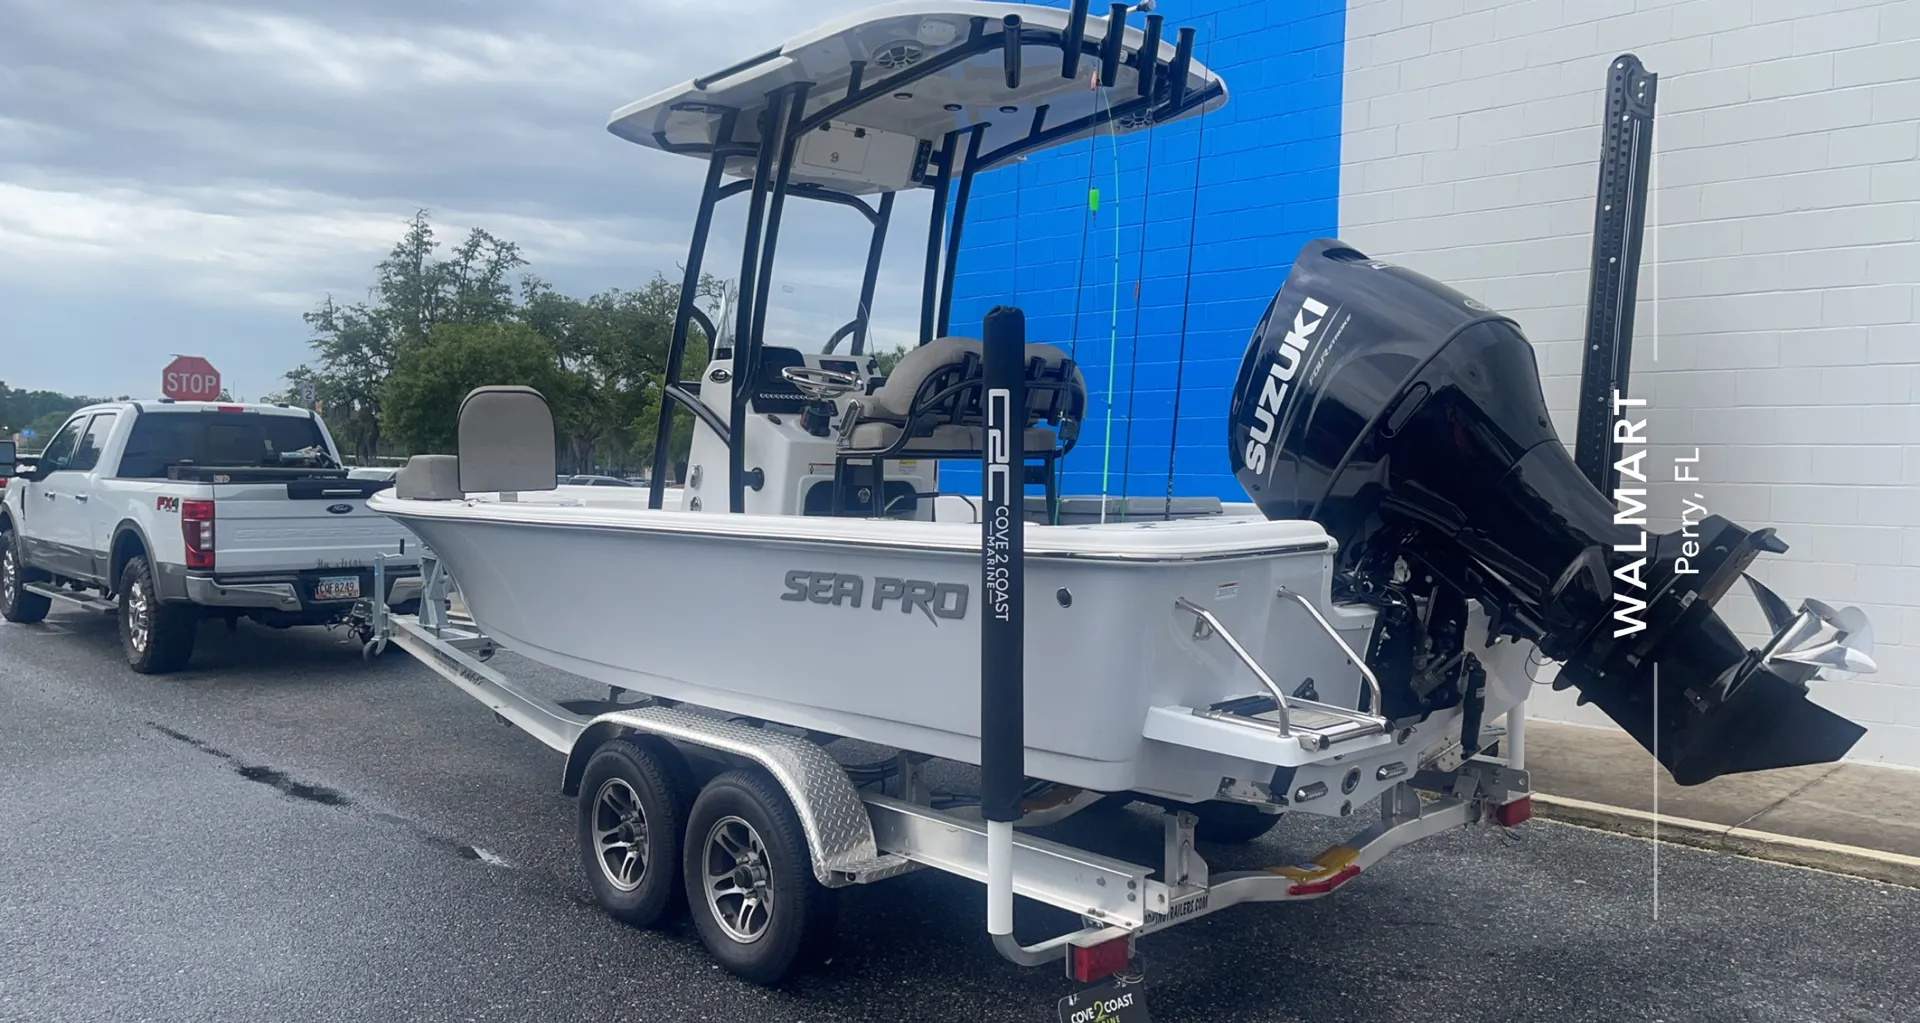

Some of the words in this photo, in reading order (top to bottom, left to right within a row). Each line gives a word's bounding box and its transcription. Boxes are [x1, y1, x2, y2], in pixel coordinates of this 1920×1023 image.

[167, 372, 217, 394] STOP
[305, 389, 313, 400] 2
[1245, 297, 1328, 474] SUZUKI
[988, 389, 1010, 506] C2C
[157, 496, 179, 510] FX4
[994, 506, 1009, 550] COVE
[986, 536, 996, 589] MARINE
[995, 554, 1009, 565] 2
[319, 581, 355, 595] CQF8249
[780, 570, 864, 609] SEA
[872, 576, 970, 627] PRO
[995, 567, 1009, 622] COAST
[1071, 1007, 1095, 1023] COVE
[1094, 1001, 1110, 1022] 2
[1104, 993, 1133, 1013] COAST
